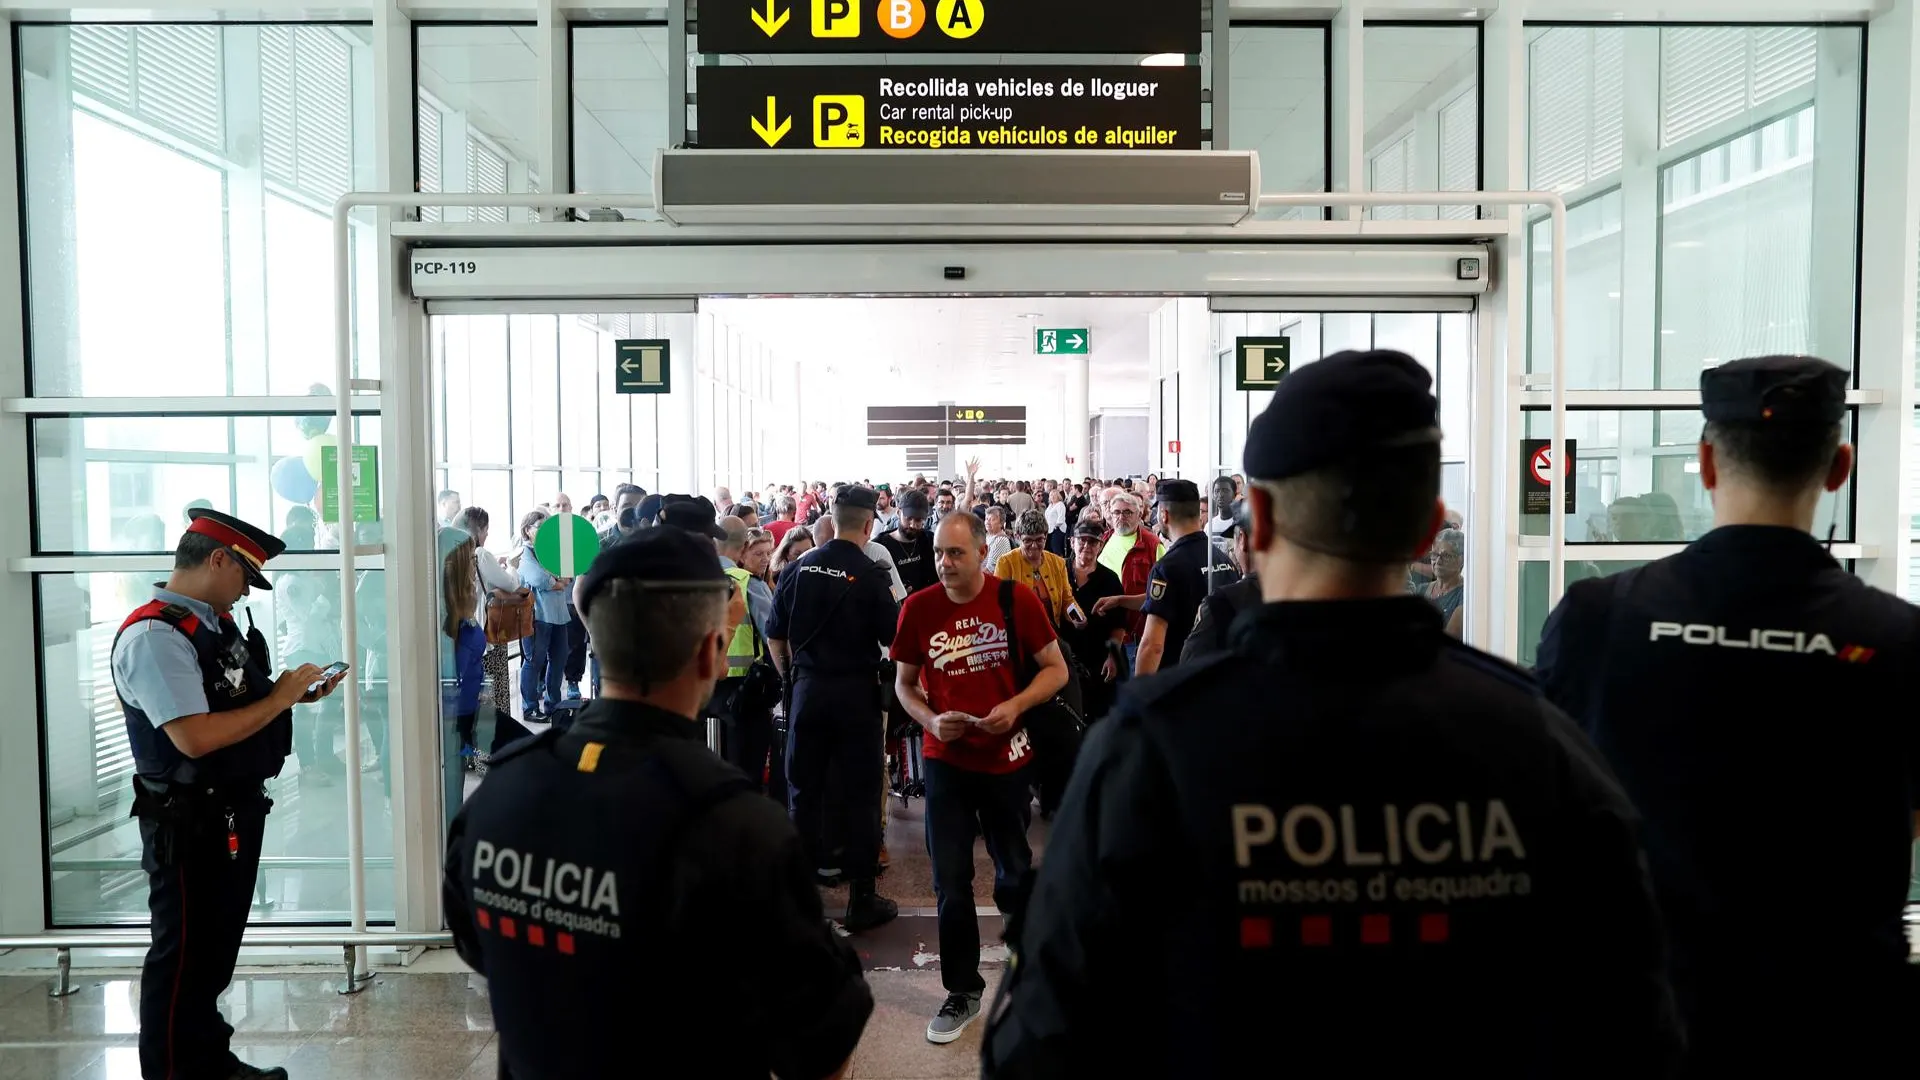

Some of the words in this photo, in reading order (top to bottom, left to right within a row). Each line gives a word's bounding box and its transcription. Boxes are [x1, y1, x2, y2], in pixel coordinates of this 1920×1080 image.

[824, 0, 850, 31] P
[889, 0, 912, 29] B
[947, 0, 973, 29] A
[880, 78, 969, 97] Recollida
[975, 78, 1054, 97] vehicles
[1060, 78, 1085, 97] de
[1091, 78, 1159, 100] lloguer
[820, 102, 849, 141] P
[880, 103, 906, 120] Car
[912, 103, 954, 120] rental
[960, 103, 1013, 123] pick-up
[880, 126, 971, 148] Recogida
[977, 126, 1068, 145] vehículos
[1074, 126, 1098, 145] de
[1105, 126, 1177, 148] alquiler
[414, 262, 477, 275] PCP-119
[800, 565, 847, 578] POLICIA
[955, 616, 982, 630] REAL
[1650, 621, 1836, 656] POLICIA
[1008, 727, 1031, 762] JP
[1231, 799, 1526, 868] POLICIA
[472, 839, 620, 916] POLICIA
[1238, 877, 1358, 904] mossos
[473, 886, 528, 916] mossos
